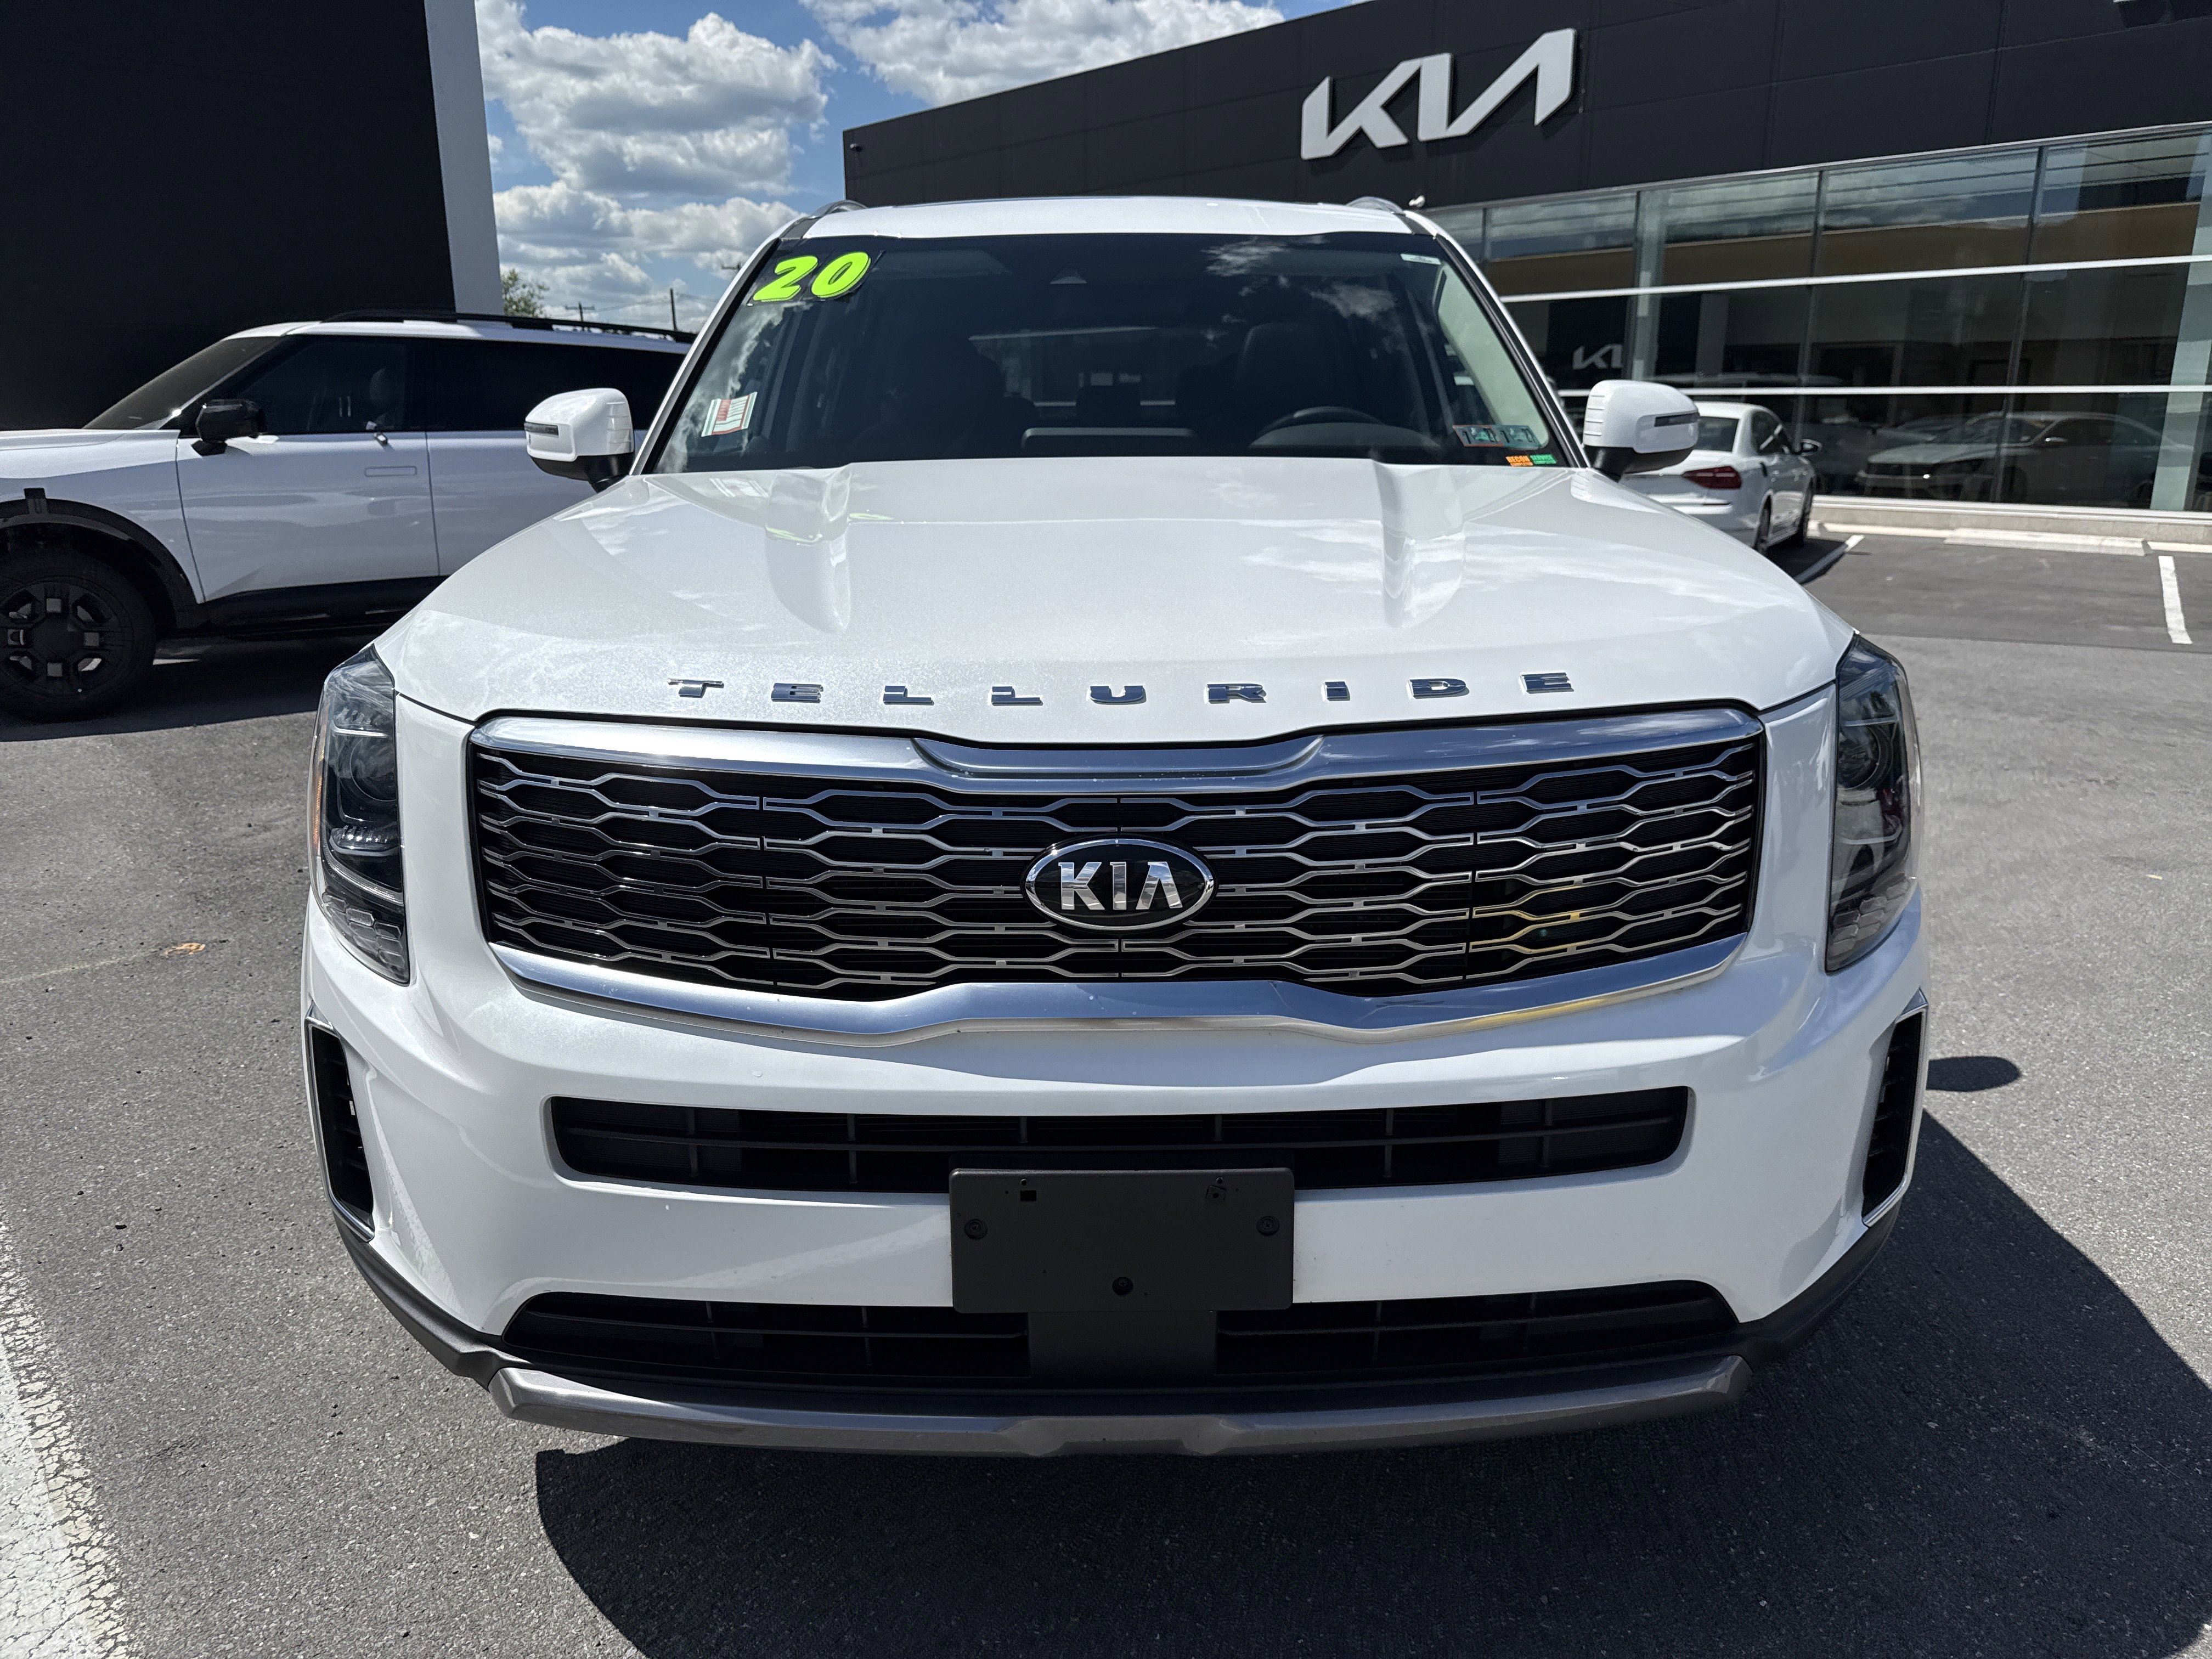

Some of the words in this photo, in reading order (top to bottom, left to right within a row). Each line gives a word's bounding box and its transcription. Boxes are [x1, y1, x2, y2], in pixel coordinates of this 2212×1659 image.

[1301, 27, 1577, 160] KIA
[753, 251, 871, 302] 20
[1572, 344, 1623, 369] KI
[667, 672, 1574, 707] TELLURIDE
[1058, 861, 1183, 910] KIA
